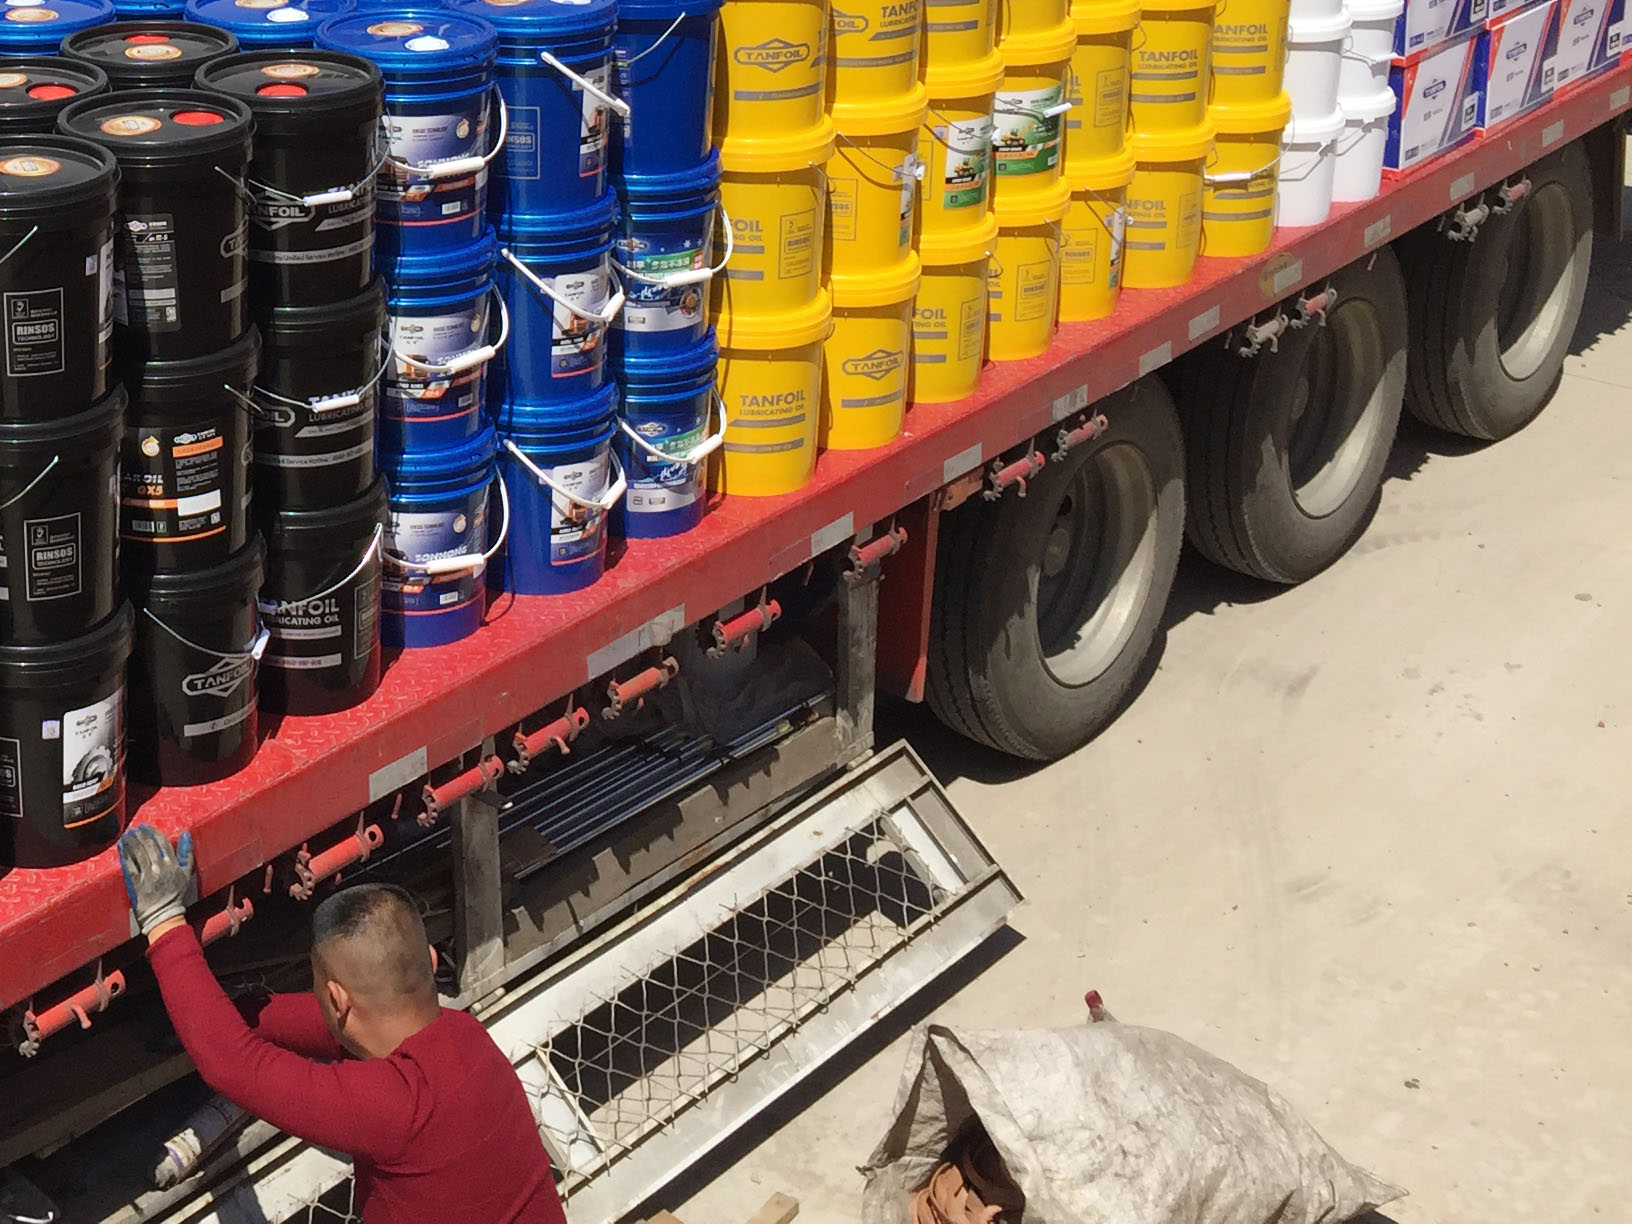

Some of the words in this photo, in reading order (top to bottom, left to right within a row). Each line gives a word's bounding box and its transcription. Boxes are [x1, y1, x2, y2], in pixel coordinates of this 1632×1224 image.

[744, 48, 803, 61] TANFOIL
[1139, 49, 1198, 62] TANFOIL
[16, 322, 56, 336] RINSOS
[740, 389, 805, 408] TANFOIL
[35, 546, 74, 561] RINSOS
